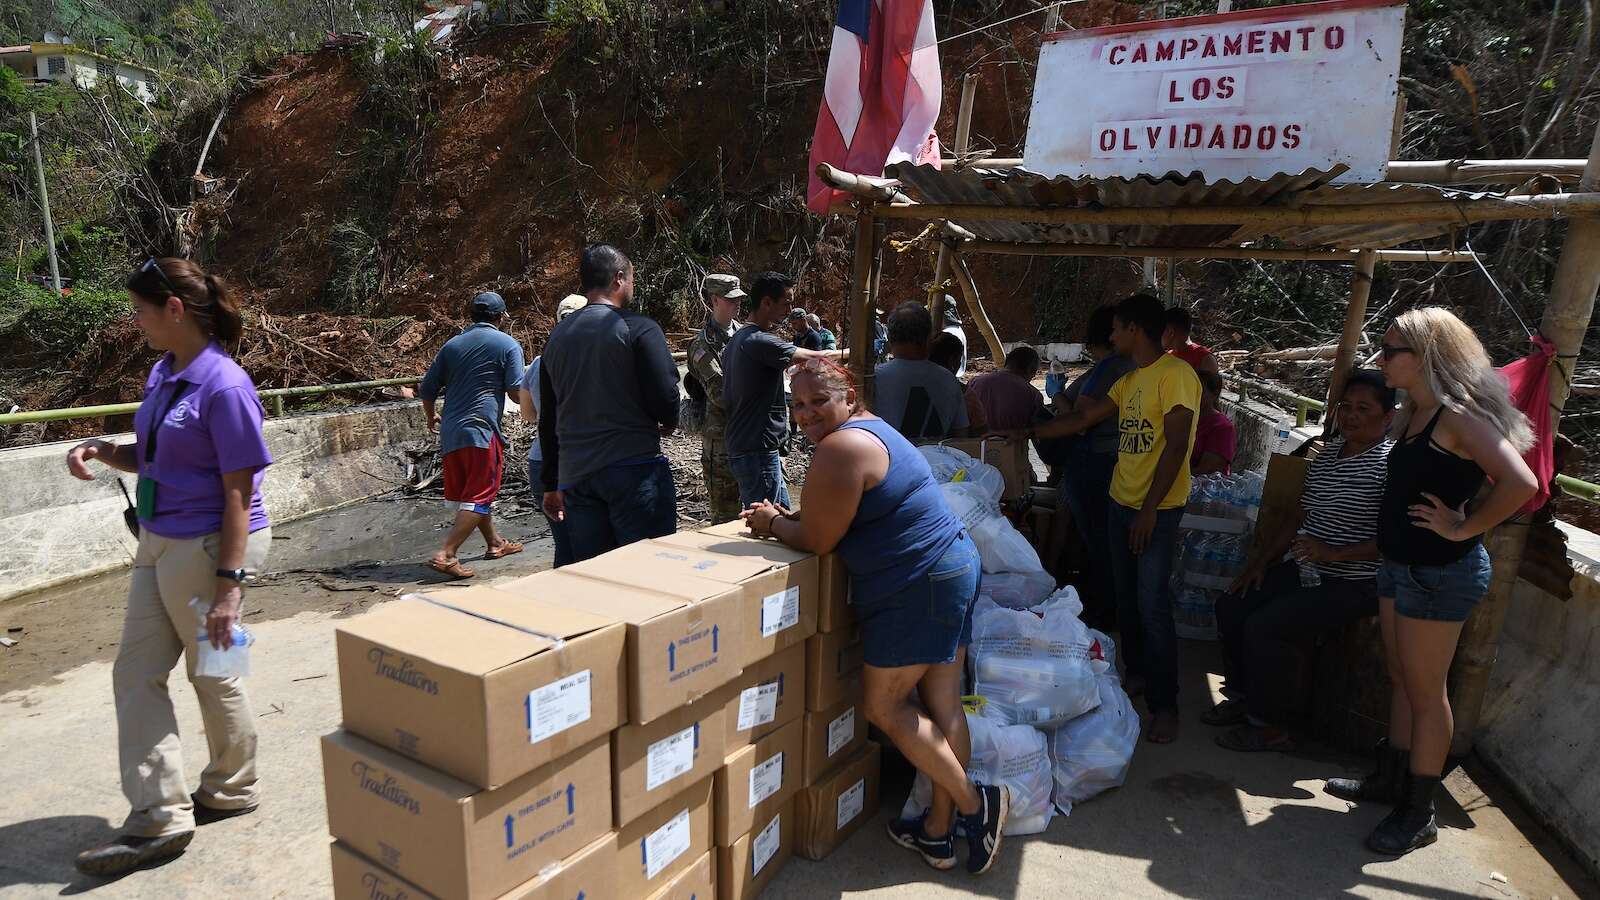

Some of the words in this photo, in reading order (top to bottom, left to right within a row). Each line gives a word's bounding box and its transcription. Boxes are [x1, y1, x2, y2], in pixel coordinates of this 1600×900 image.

[1109, 26, 1344, 65] CAMPAMENTO
[1169, 76, 1235, 103] LOS
[1099, 123, 1302, 152] OLVIDADOS
[678, 636, 690, 646] THIS
[690, 631, 702, 642] SIDE
[703, 627, 710, 637] UP
[368, 647, 438, 695] Traditions
[669, 668, 690, 682] HANDLE
[691, 662, 704, 673] WITH
[704, 655, 718, 668] CARE
[352, 760, 420, 816] Traditions
[518, 803, 534, 816] THIS
[535, 795, 551, 808] SIDE
[552, 789, 562, 801] UP
[507, 837, 536, 860] HANDLE
[538, 829, 555, 843] WITH
[555, 817, 575, 833] CARE
